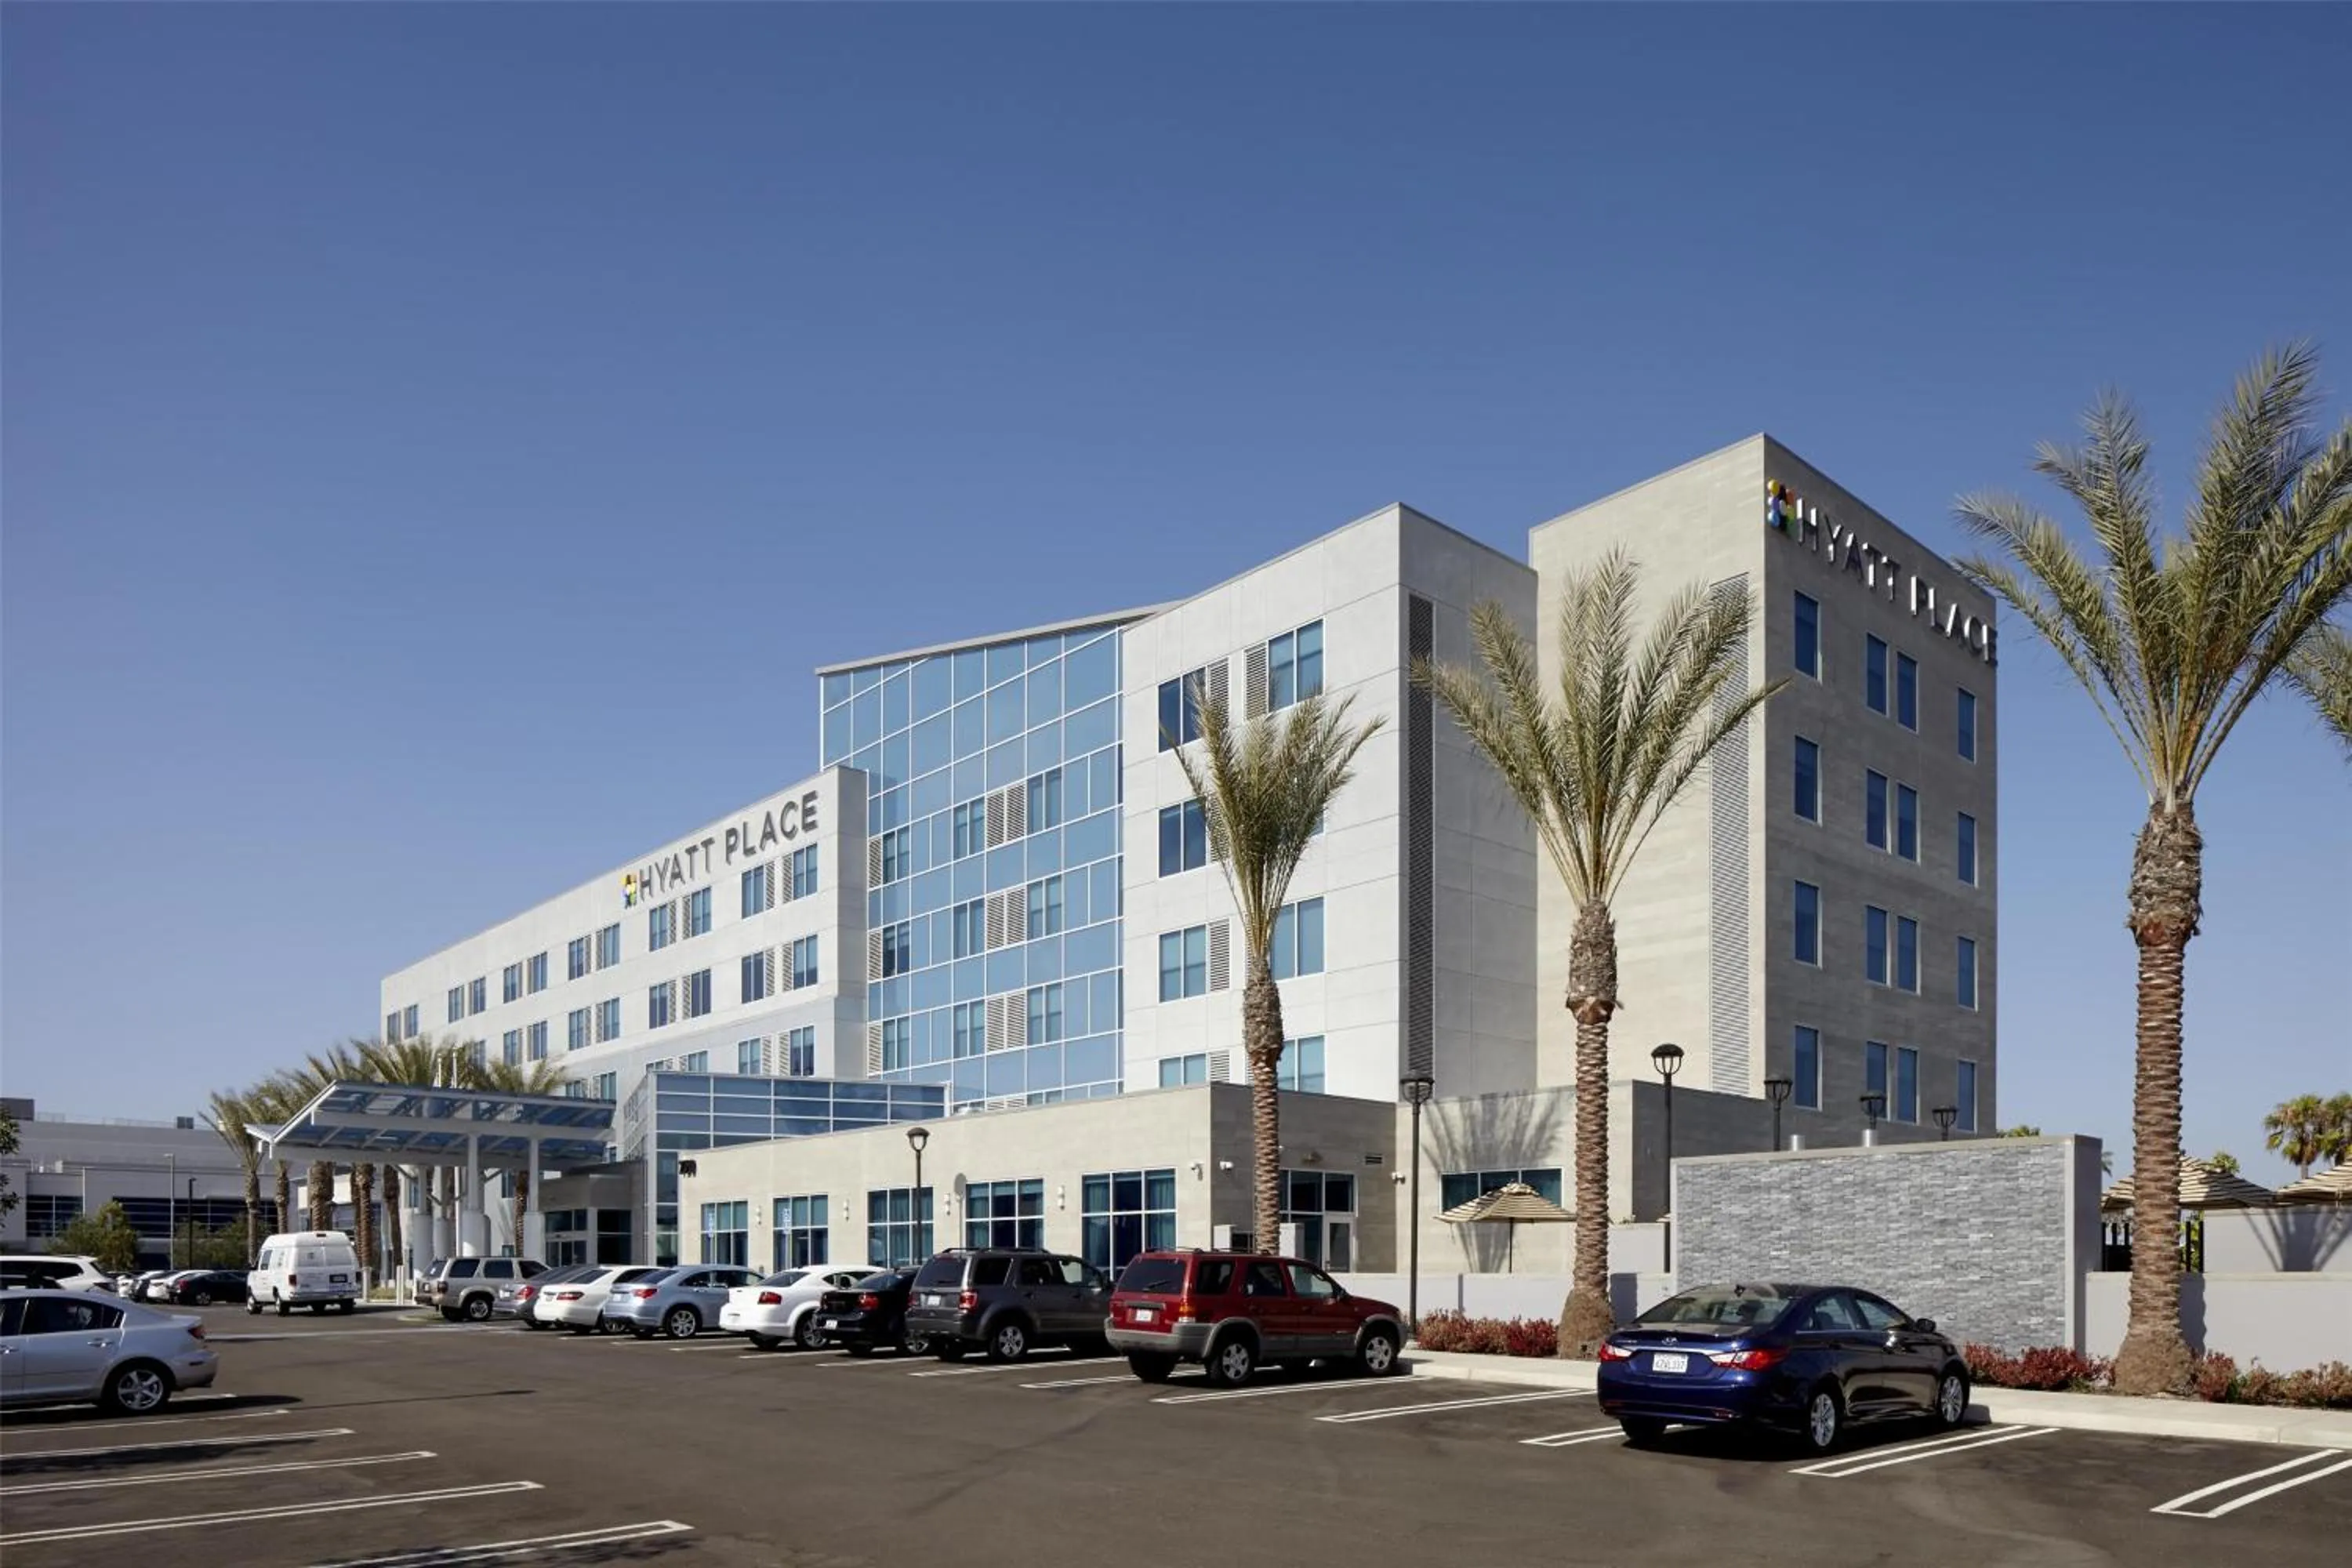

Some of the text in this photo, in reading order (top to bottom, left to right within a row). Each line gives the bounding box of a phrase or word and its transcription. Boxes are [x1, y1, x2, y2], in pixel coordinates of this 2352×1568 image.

[1797, 498, 1900, 602] HYATT
[640, 790, 818, 902] HYATT PLACE
